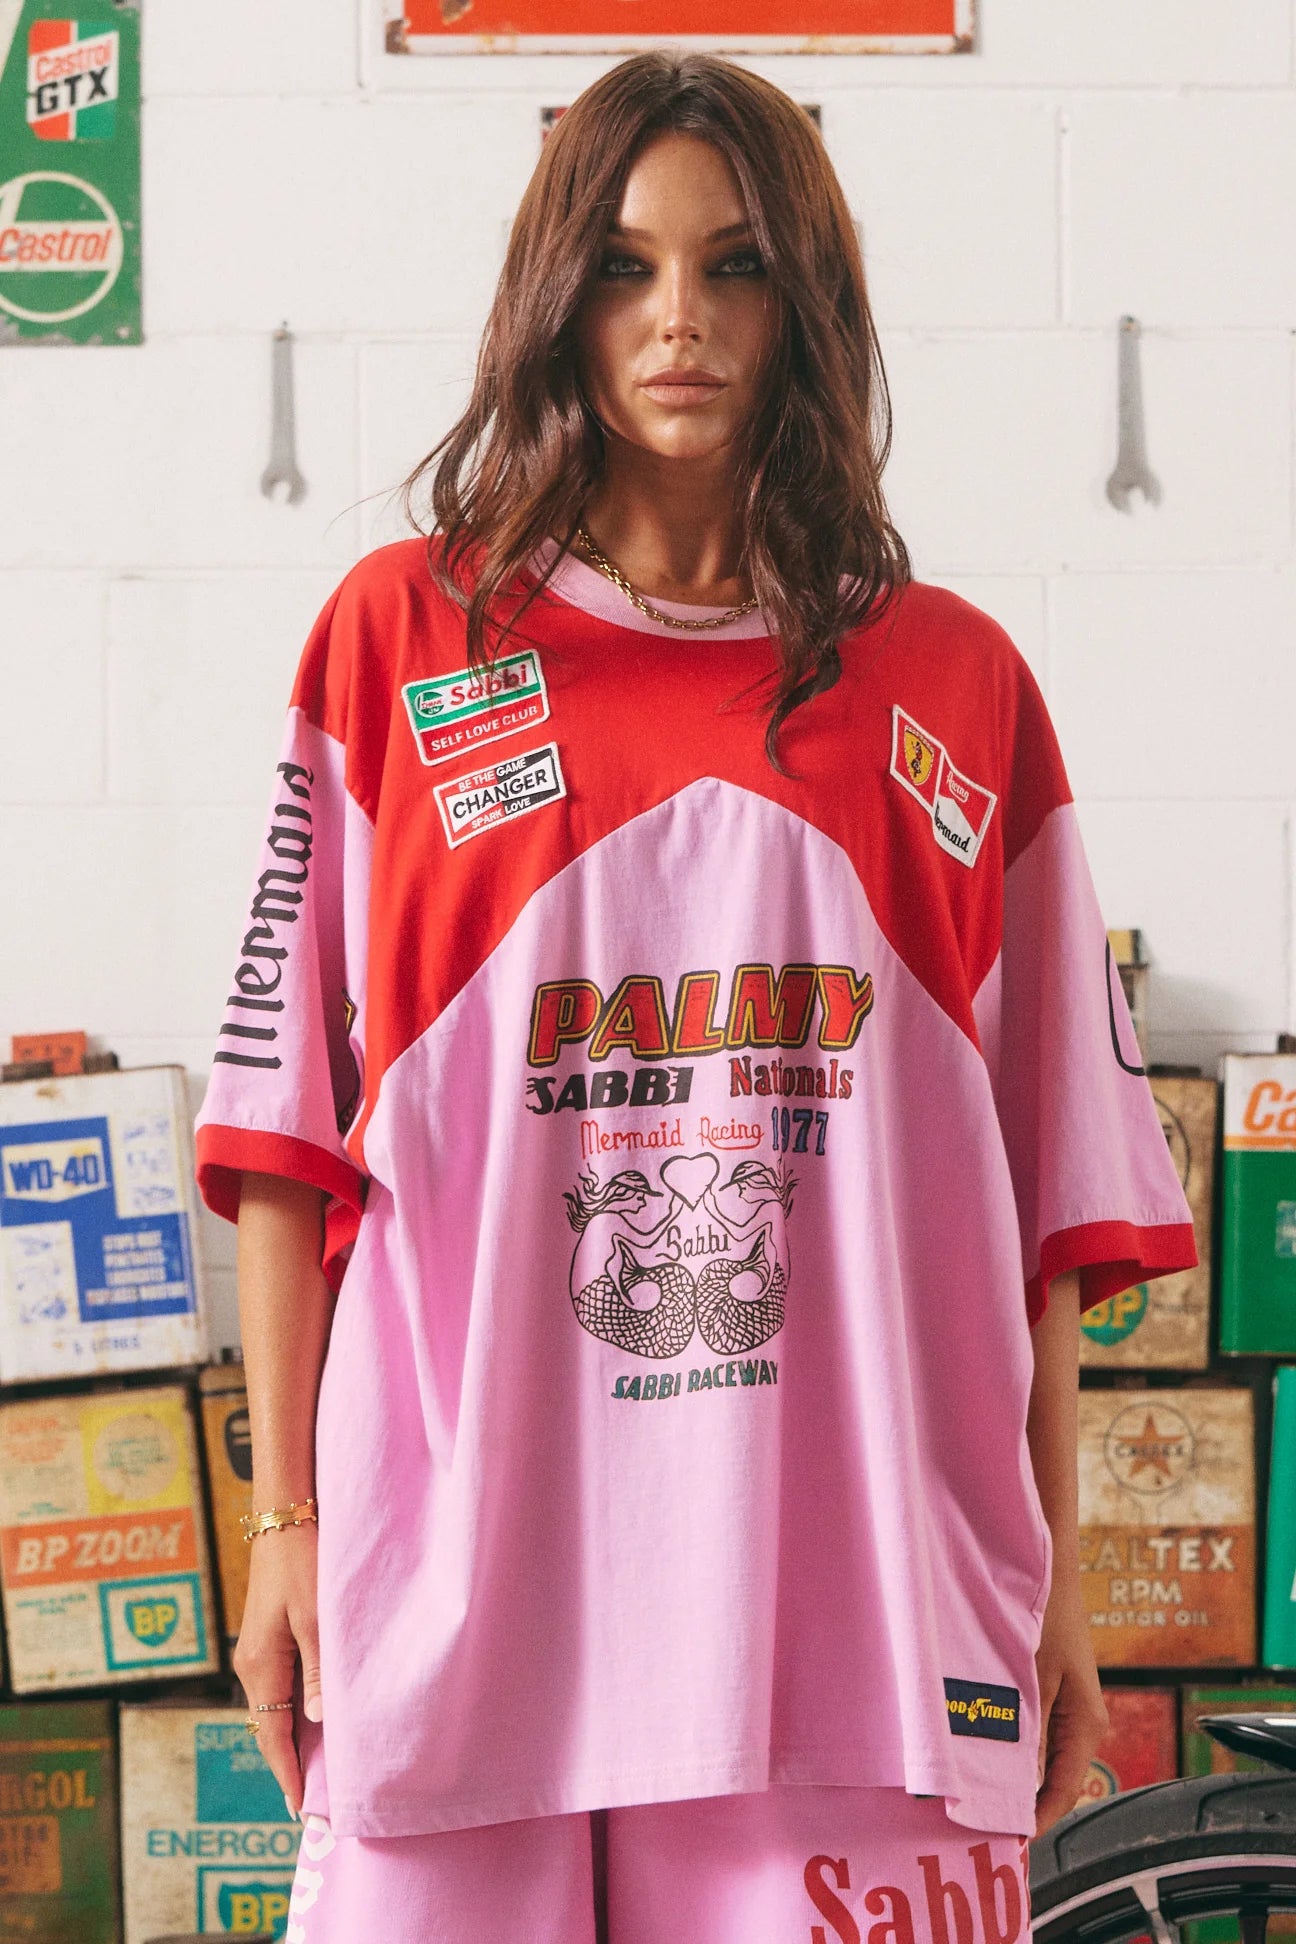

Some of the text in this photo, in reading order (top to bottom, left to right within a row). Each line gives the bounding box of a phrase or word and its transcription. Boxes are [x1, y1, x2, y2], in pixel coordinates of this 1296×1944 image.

[37, 40, 112, 82] Castrol
[36, 66, 109, 116] GTX
[0, 228, 113, 263] Castrol
[450, 664, 528, 706] Sabbi
[431, 706, 538, 751] SELF LOVE CLUB
[453, 768, 548, 819] CHANGER
[459, 758, 527, 792] BE THE GAME
[471, 799, 531, 829] SPARK LOVE
[526, 963, 874, 1067] PALMY
[526, 1056, 854, 1115] SABBI Nationals
[580, 1106, 829, 1160] Mermaid Racing 1977
[9, 1153, 99, 1192] WD-40
[655, 1224, 731, 1262] Sabbi
[611, 1359, 780, 1400] SABBI RACEWAY
[16, 1521, 186, 1575] BP ZOOM
[1109, 1578, 1183, 1605] RPM
[133, 1603, 176, 1636] BP
[1090, 1610, 1209, 1627] MOTOR OIL
[978, 1700, 1016, 1721] VIBES
[230, 1893, 291, 1935] BP
